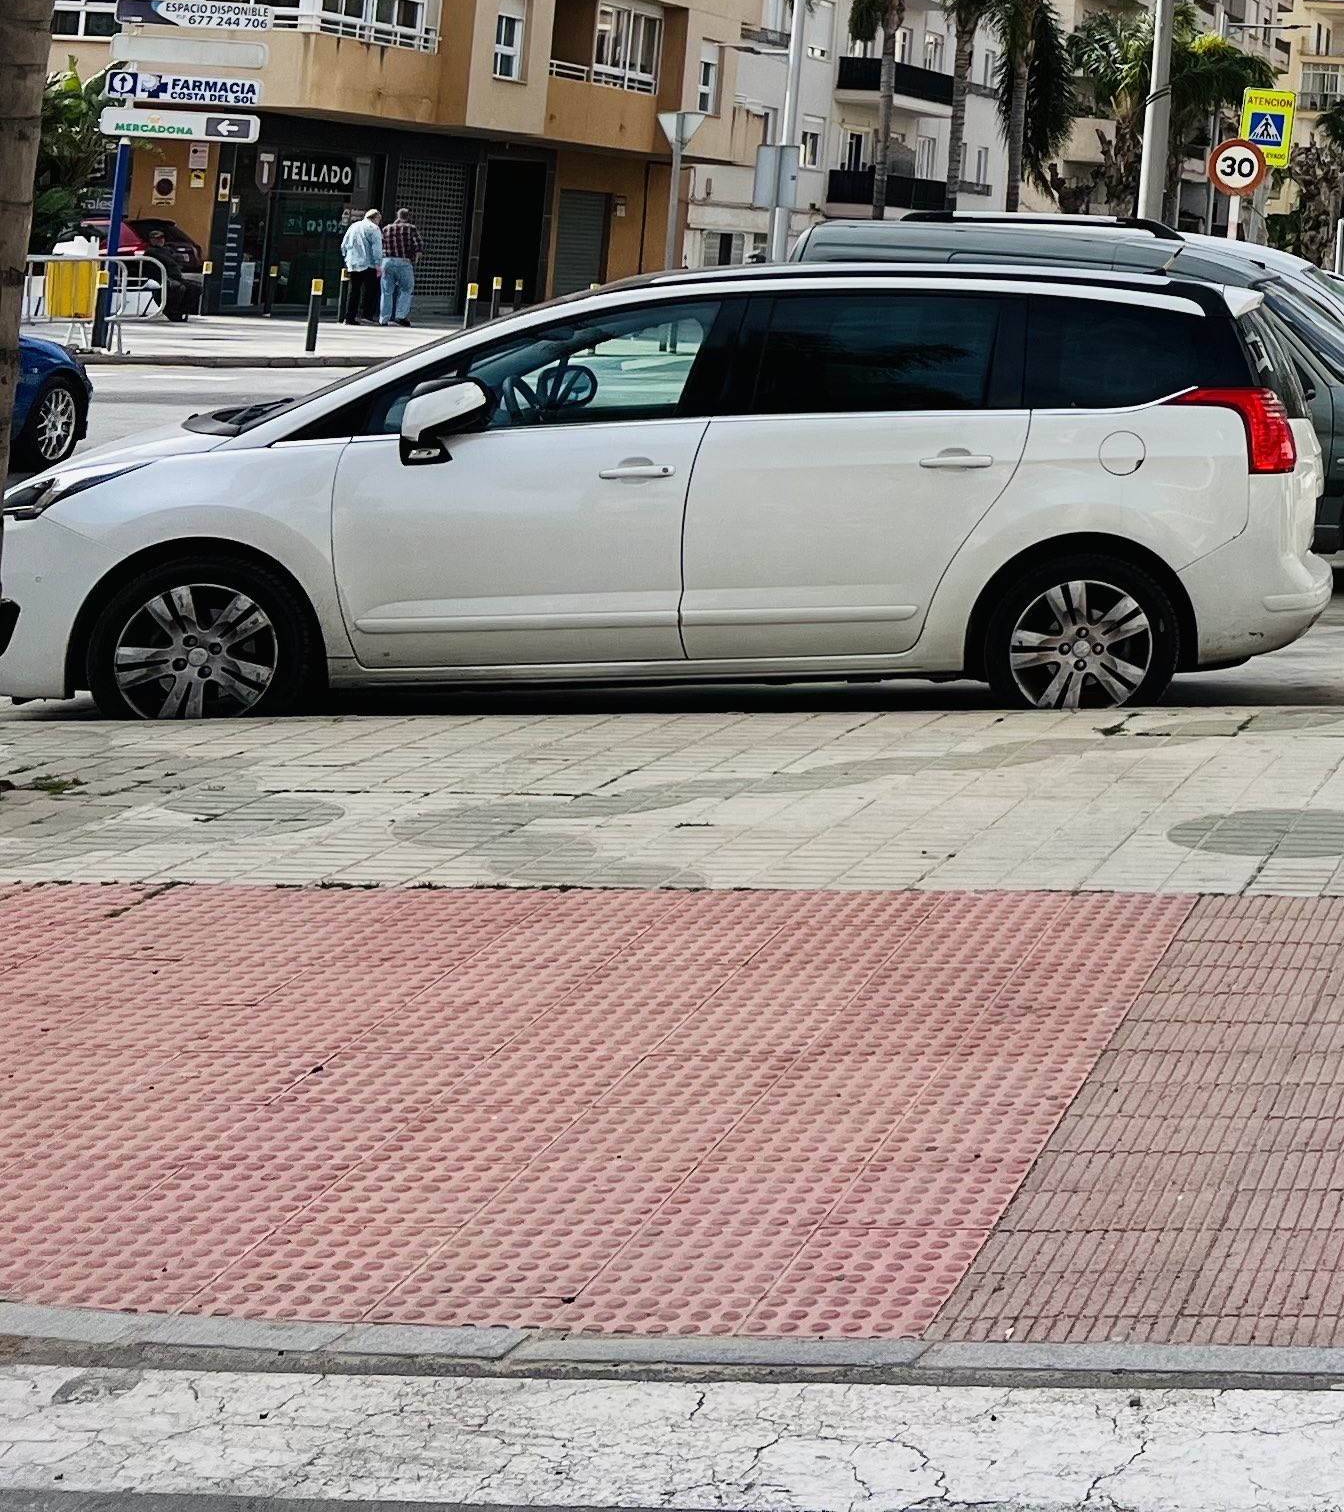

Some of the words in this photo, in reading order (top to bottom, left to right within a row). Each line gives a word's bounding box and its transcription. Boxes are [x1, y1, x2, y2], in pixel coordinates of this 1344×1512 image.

[165, 2, 208, 14] ESPACIO
[211, 4, 269, 18] DISPONIBLE
[188, 15, 213, 26] 677
[216, 17, 241, 28] 244
[244, 18, 268, 29] 706
[171, 78, 257, 96] FARMACIA
[170, 91, 206, 102] COSTA
[209, 94, 231, 104] DEL
[233, 95, 256, 105] SOL
[1247, 96, 1293, 108] ATENCION
[114, 122, 194, 136] MERCADONA
[282, 160, 352, 185] TELLADO
[1219, 155, 1255, 178] 30
